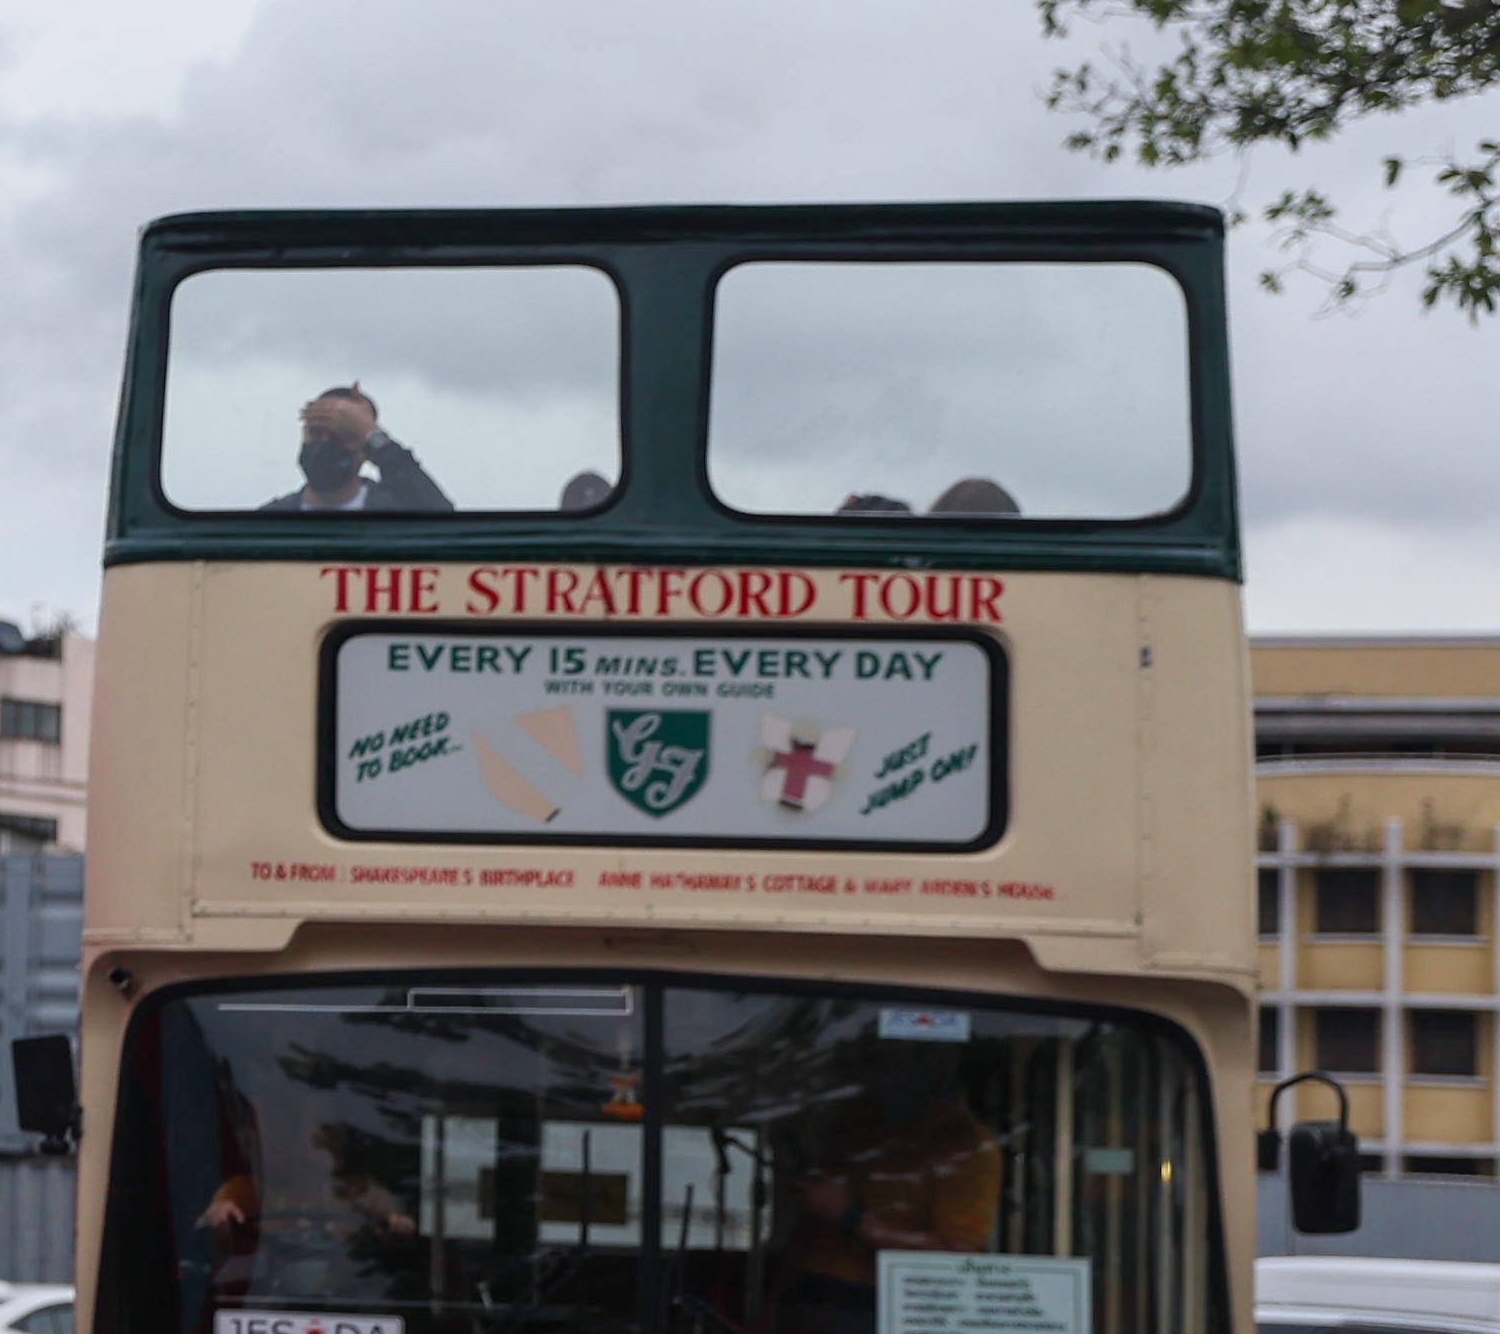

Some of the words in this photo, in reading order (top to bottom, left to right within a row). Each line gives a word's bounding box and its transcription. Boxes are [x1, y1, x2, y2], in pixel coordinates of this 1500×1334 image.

[320, 566, 440, 614] THE
[465, 566, 816, 617] STRATFORD
[839, 572, 1005, 622] TOUR
[388, 644, 533, 674] EVERY
[550, 647, 587, 674] 15
[692, 649, 842, 679] EVERY
[854, 651, 943, 681] DAY
[544, 680, 594, 695] WITH
[603, 681, 654, 696] YOUR
[662, 682, 709, 697] OWN
[716, 683, 776, 698] GUIDE
[348, 732, 385, 760] NO
[387, 712, 450, 746] NEED
[875, 730, 933, 779] JUST
[356, 755, 383, 782] TO
[858, 767, 926, 816] JUMP
[251, 861, 270, 881] TO
